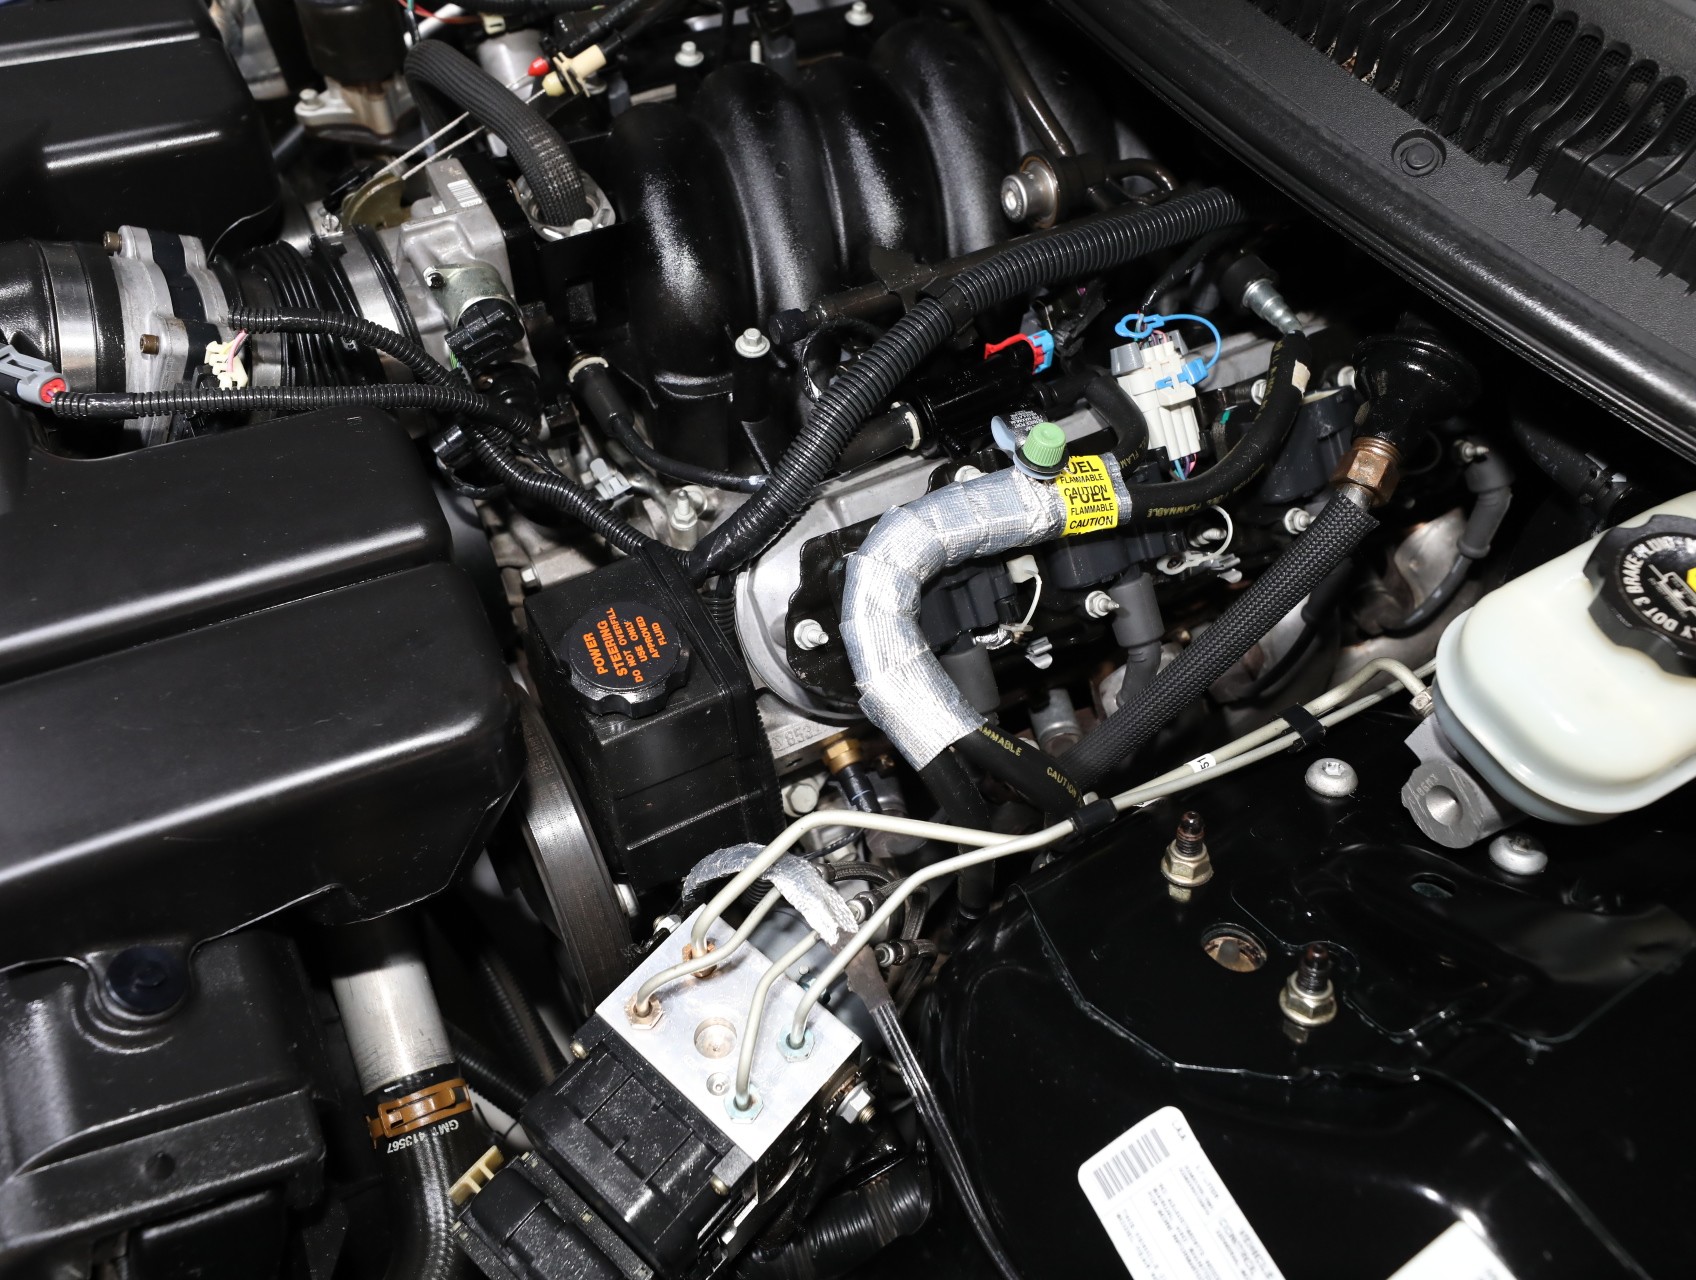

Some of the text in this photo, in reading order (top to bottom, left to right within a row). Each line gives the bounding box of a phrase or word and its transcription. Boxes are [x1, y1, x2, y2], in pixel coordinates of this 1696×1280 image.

[1067, 461, 1100, 475] UEL
[1060, 473, 1104, 484] FLAMMABLE
[1063, 484, 1108, 497] CAUTION
[1069, 489, 1111, 505] FUEL
[1070, 502, 1115, 516] FLAMMABLE
[1069, 515, 1114, 530] CAUTION
[1622, 553, 1645, 594] BRAKE
[1633, 596, 1651, 606] 3
[1641, 607, 1679, 632] DOT
[623, 621, 648, 662] USE ONLY
[635, 615, 660, 658] APPROVED
[651, 622, 667, 646] FLUID
[583, 632, 609, 675] POWER
[597, 620, 628, 677] STEERING
[606, 607, 644, 683] DO NOT OVERFILL
[1197, 757, 1210, 770] 51
